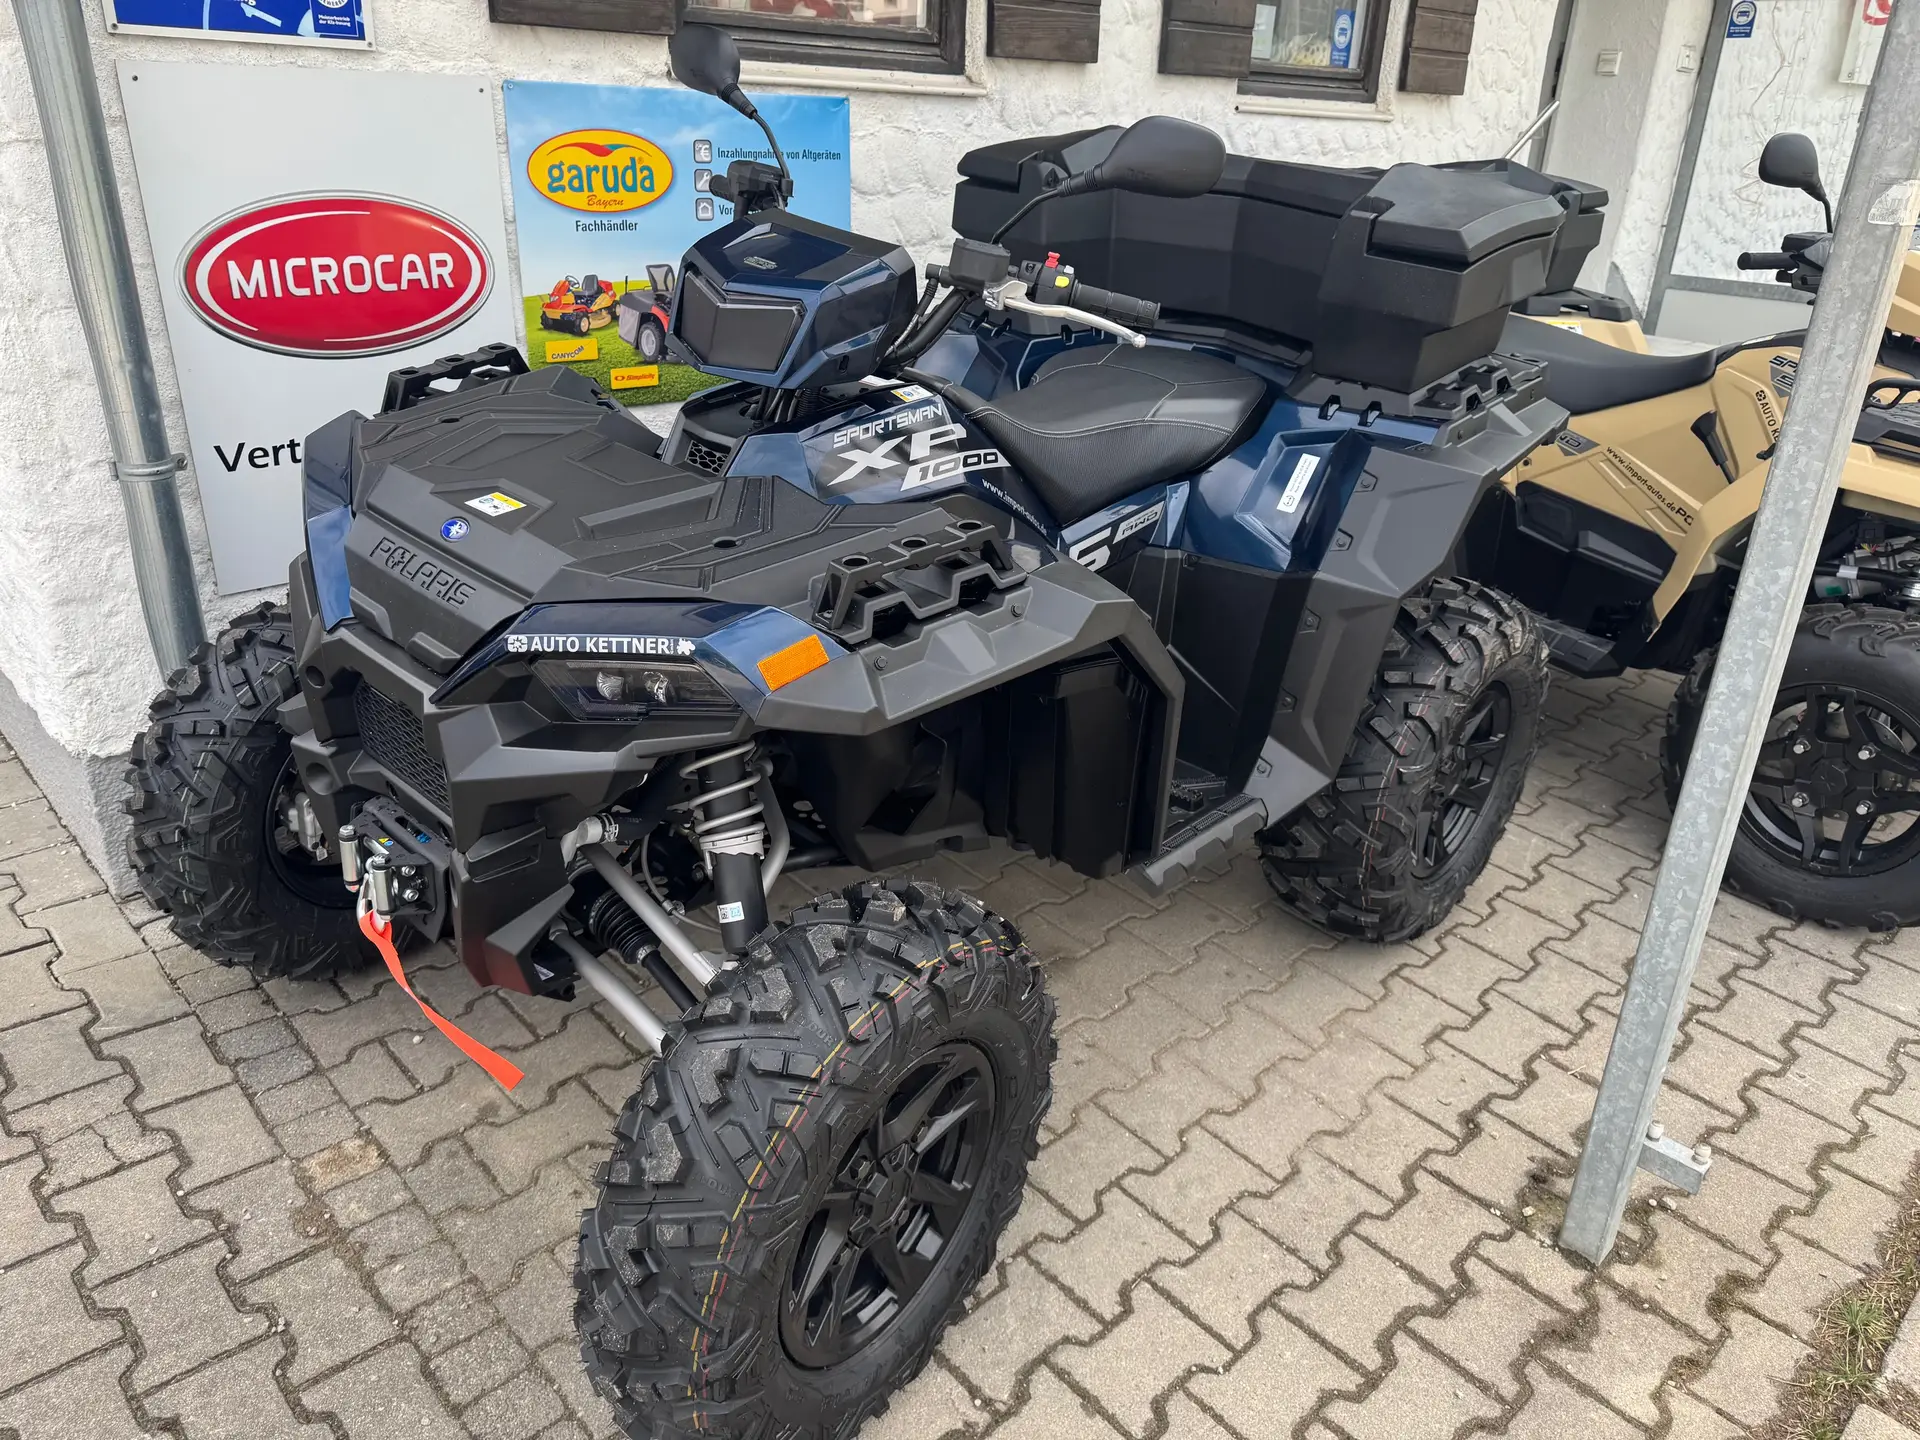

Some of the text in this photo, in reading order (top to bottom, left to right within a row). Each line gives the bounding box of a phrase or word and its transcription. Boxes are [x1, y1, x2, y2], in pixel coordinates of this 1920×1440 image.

[787, 151, 800, 160] von
[801, 149, 841, 162] Altgeräten
[547, 157, 655, 193] garuda
[586, 194, 625, 209] Bayern
[575, 219, 639, 232] Fachhändler
[226, 252, 455, 300] MICROCAR
[551, 345, 585, 360] CANYCOM
[832, 403, 942, 449] SPORTSMAN
[1760, 401, 1776, 427] AUTO
[213, 438, 302, 472] Vert
[827, 423, 967, 486] XP
[918, 451, 999, 482] 1000
[1606, 446, 1676, 512] www.import-autos.de
[1121, 511, 1158, 536] AWD
[369, 536, 477, 610] POLARIS
[530, 636, 580, 653] AUTO
[586, 637, 671, 654] KETTNER
